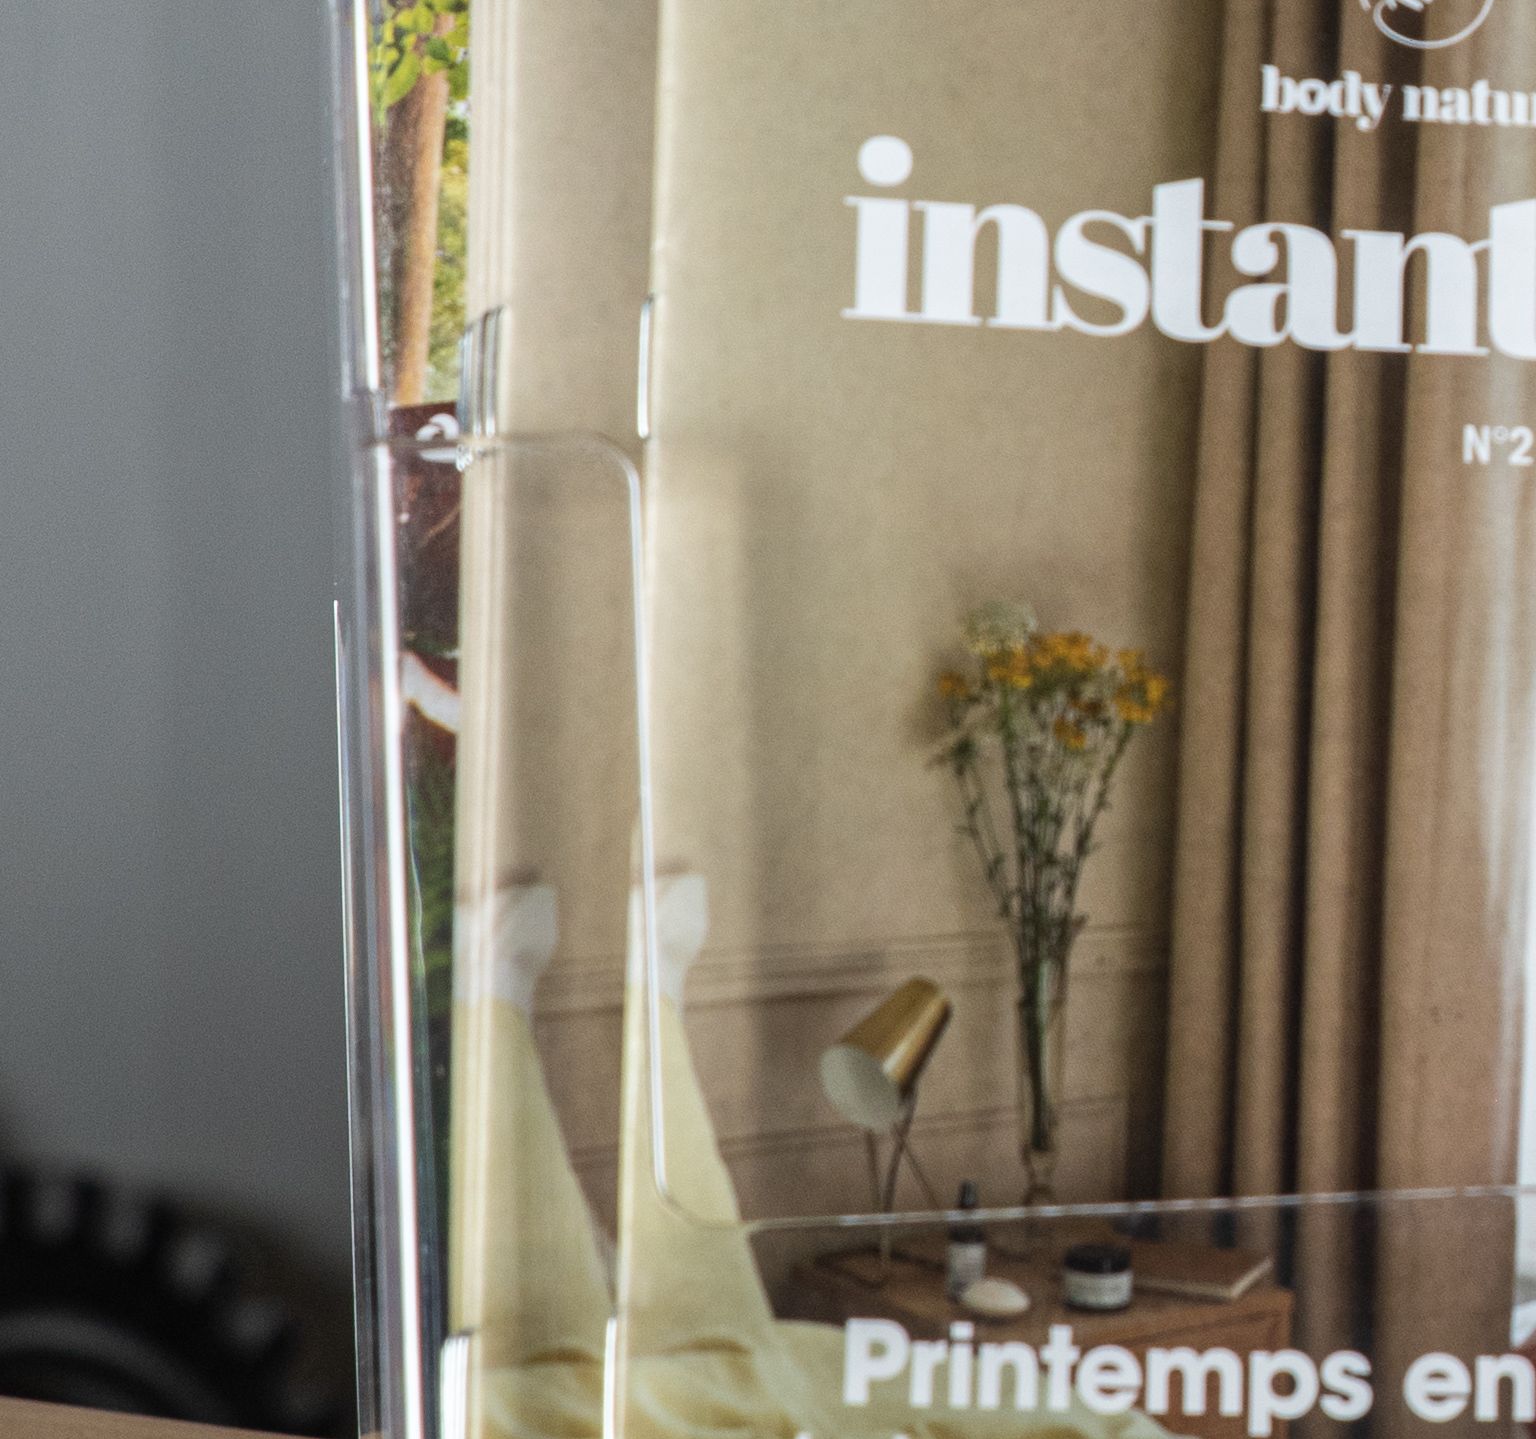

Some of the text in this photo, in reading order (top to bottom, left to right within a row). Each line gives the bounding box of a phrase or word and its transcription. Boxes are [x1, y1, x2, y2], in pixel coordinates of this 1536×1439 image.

[1260, 64, 1392, 131] body
[1463, 424, 1534, 467] N°2
[843, 1318, 1373, 1437] Printemps
[1403, 1351, 1536, 1423] en
